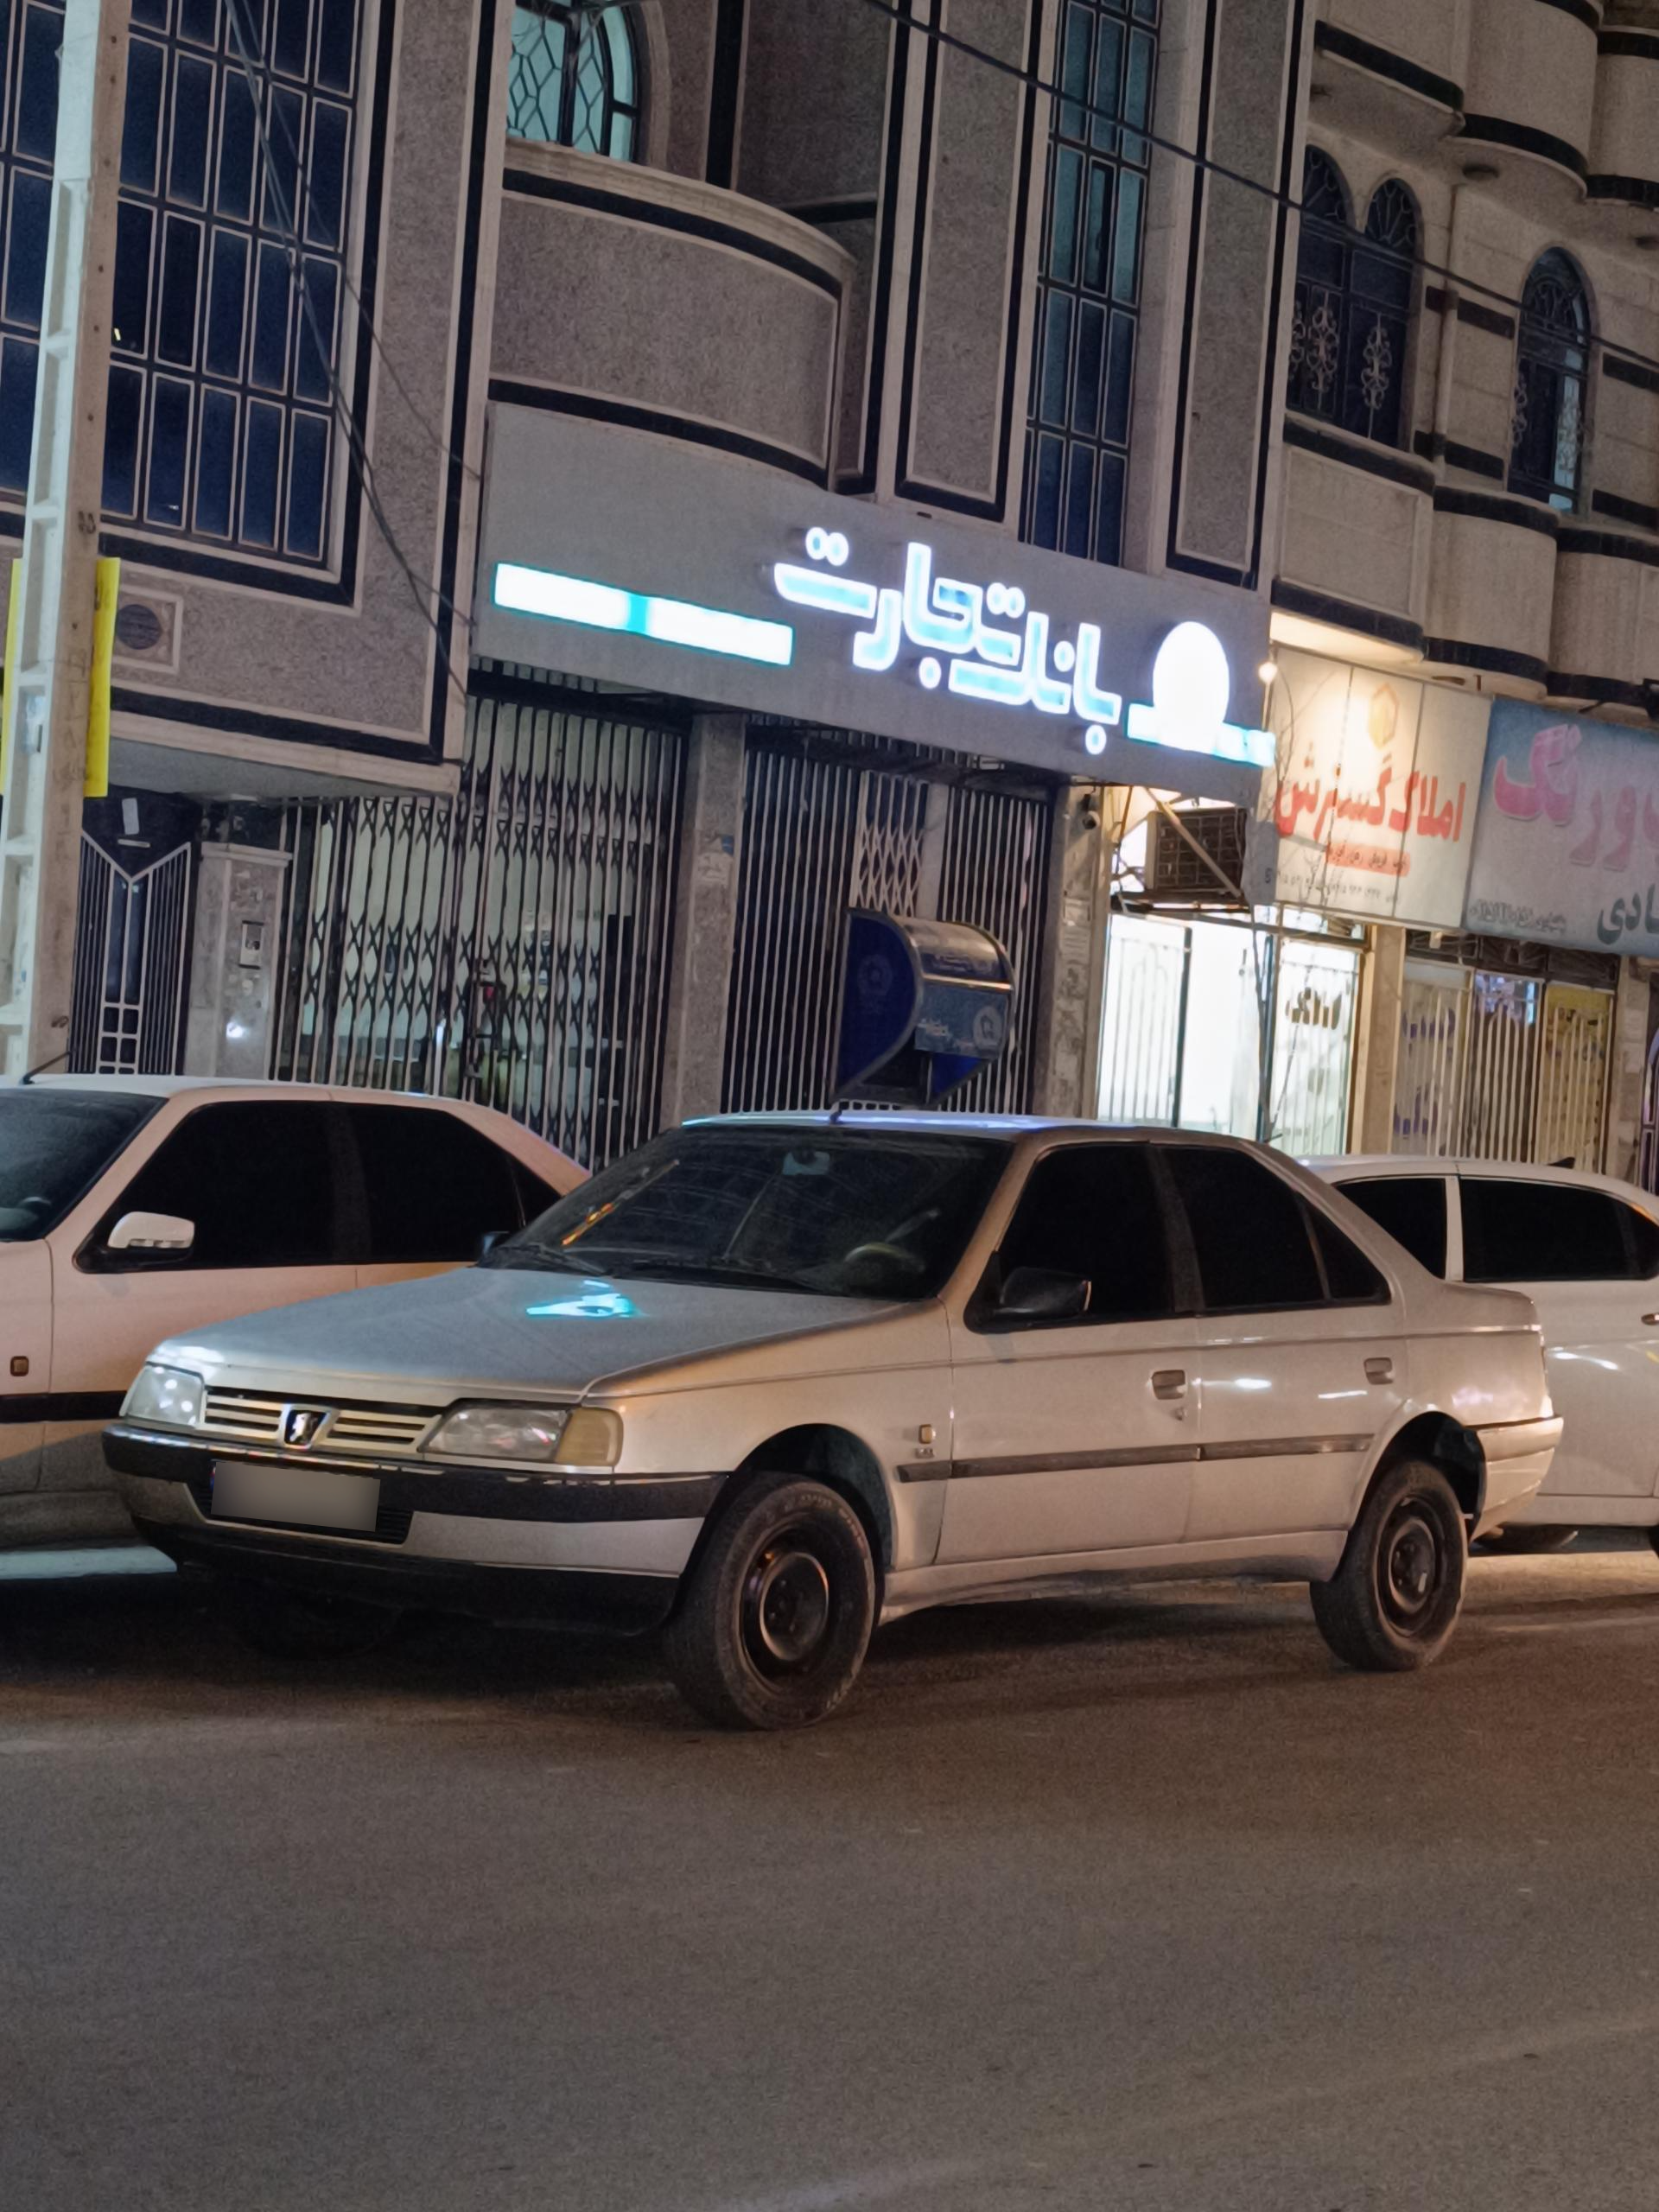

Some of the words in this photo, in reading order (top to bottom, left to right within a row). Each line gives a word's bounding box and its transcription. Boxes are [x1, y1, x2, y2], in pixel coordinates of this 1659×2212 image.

[774, 526, 1026, 690] تجارت
[949, 611, 1123, 754] بانک
[1273, 745, 1393, 843] گسترش
[1388, 771, 1467, 842] املاک
